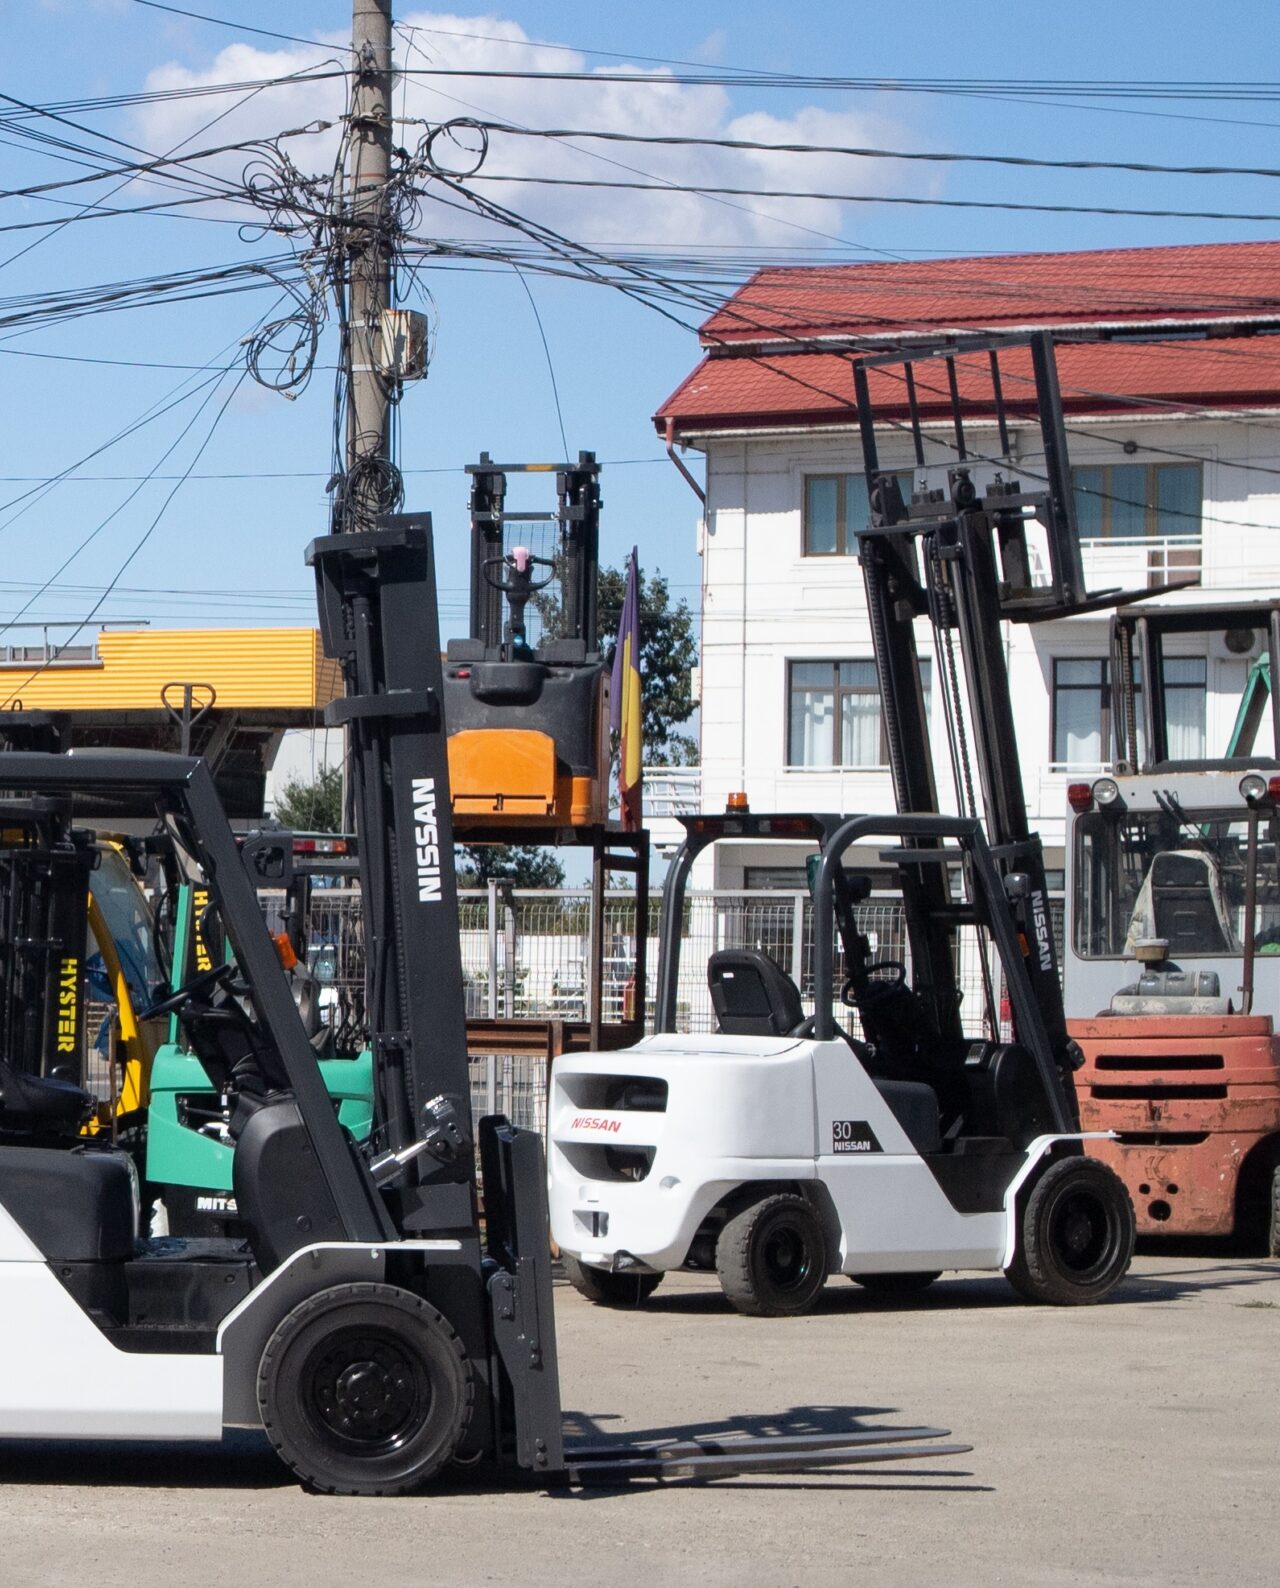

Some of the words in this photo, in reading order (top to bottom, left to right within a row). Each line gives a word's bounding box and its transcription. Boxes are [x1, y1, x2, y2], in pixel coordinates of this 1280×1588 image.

[412, 778, 442, 902] NISSAN
[194, 891, 212, 972] HYER
[1031, 890, 1052, 972] NISSAN
[57, 958, 77, 1053] HYSTER
[571, 1118, 622, 1133] NISSAN
[833, 1122, 852, 1139] 30
[834, 1141, 871, 1151] NISSAN
[197, 1196, 238, 1211] MITS
